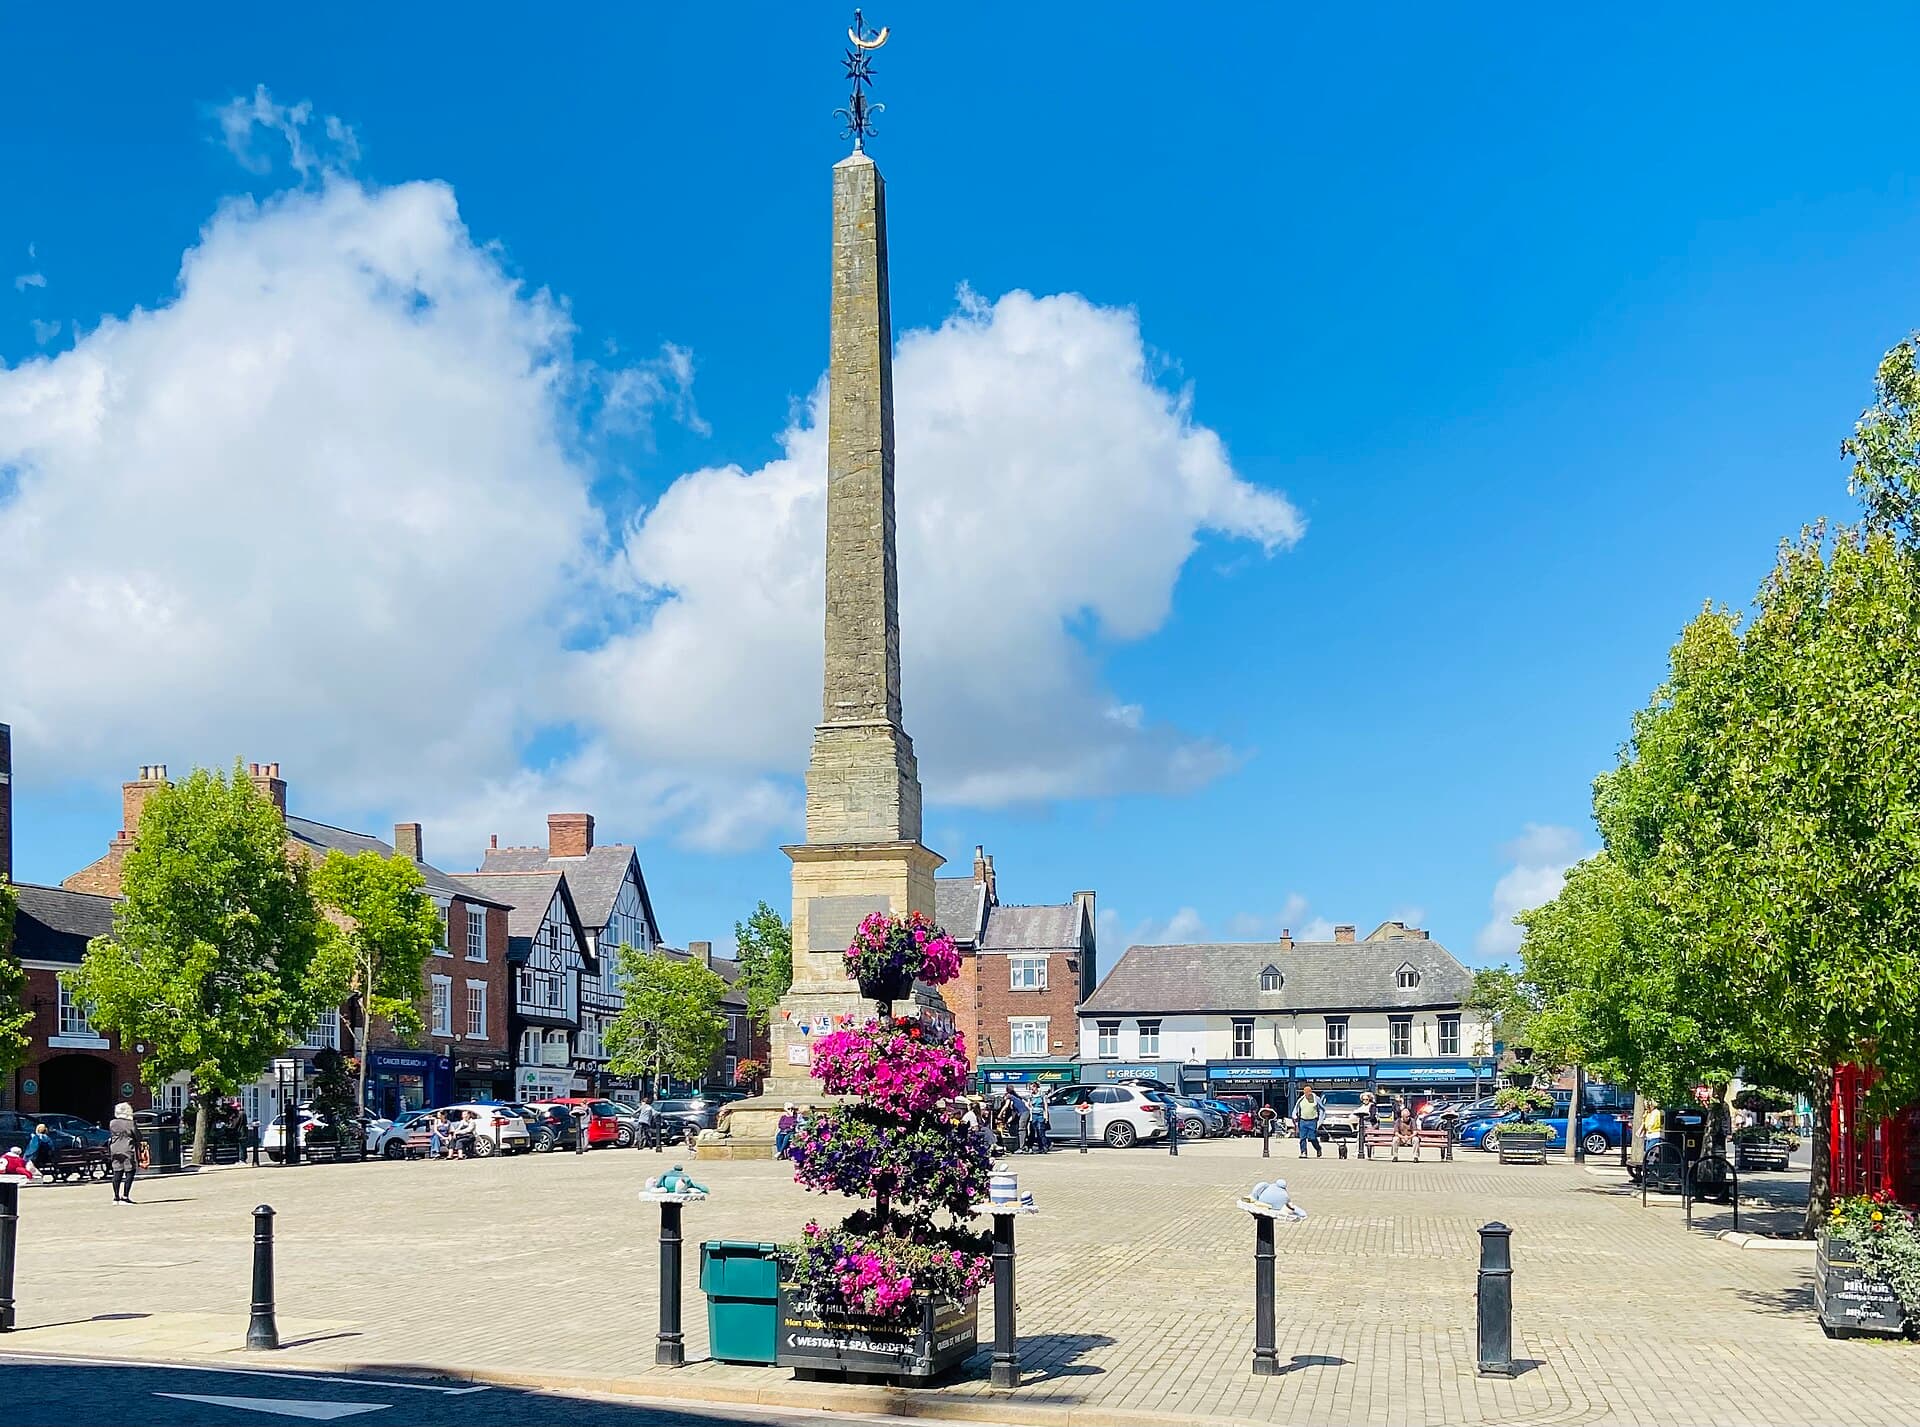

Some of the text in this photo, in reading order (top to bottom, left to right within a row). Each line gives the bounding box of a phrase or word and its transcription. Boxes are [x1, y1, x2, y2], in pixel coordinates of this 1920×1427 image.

[1116, 1069, 1156, 1078] GREGGS
[848, 1341, 868, 1351] SPA
[868, 1342, 914, 1354] GARDENS
